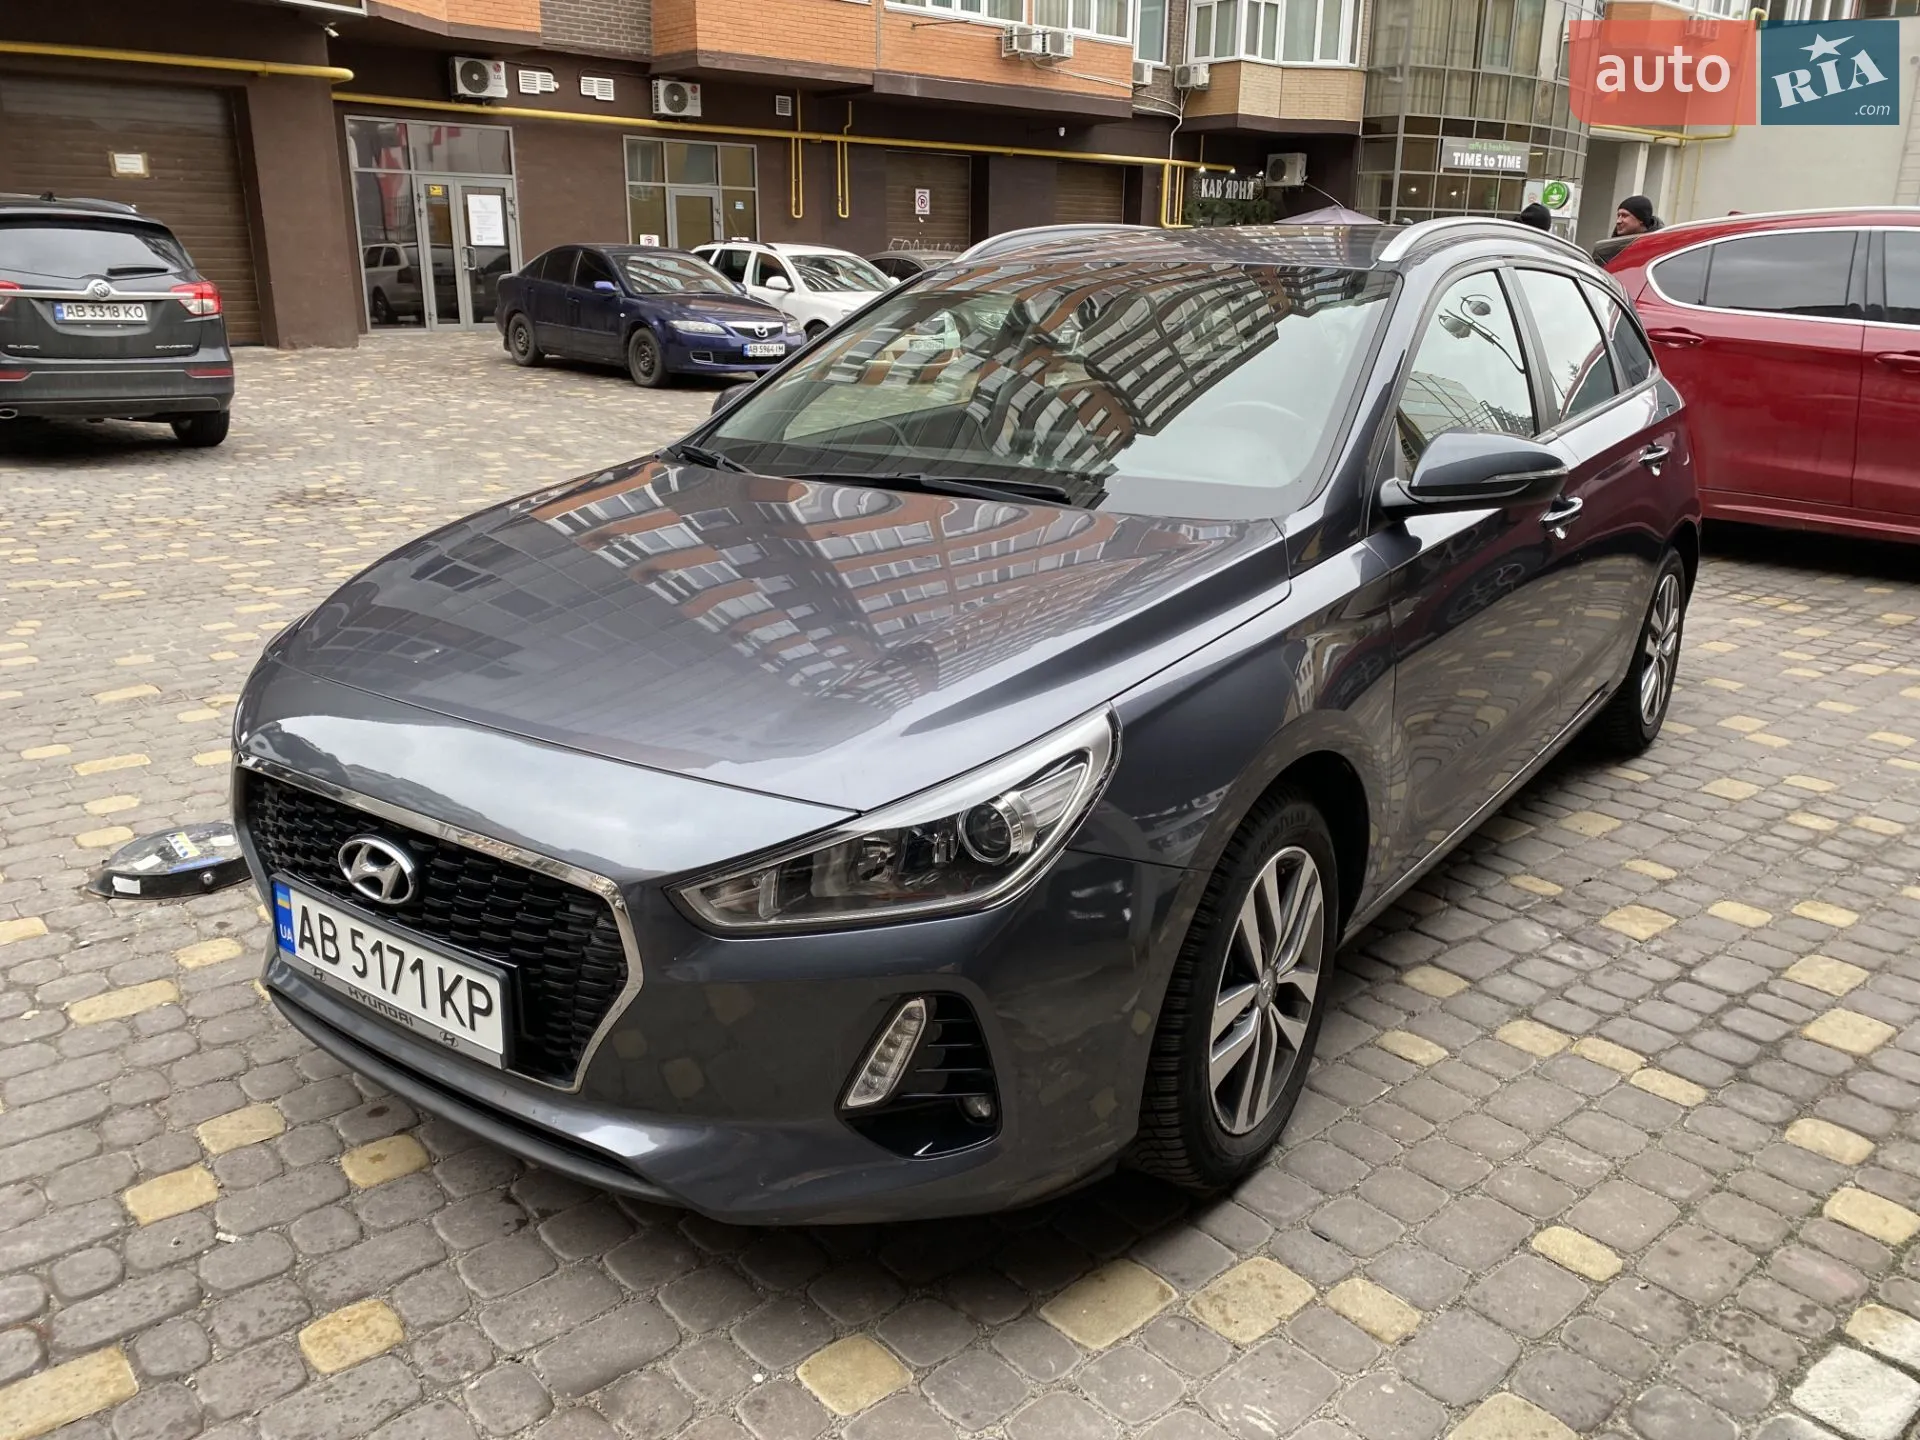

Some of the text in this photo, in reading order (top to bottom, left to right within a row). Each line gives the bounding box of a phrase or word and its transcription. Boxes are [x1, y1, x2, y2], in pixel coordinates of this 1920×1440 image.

[1453, 152, 1521, 169] TIME to TIME
[1201, 177, 1254, 200] КАВ'ЯРНЯ
[66, 305, 144, 318] AB 3318 KO
[280, 923, 293, 942] UA
[298, 905, 493, 1031] AB 5171 KP
[348, 987, 414, 1027] HYUNDAI
